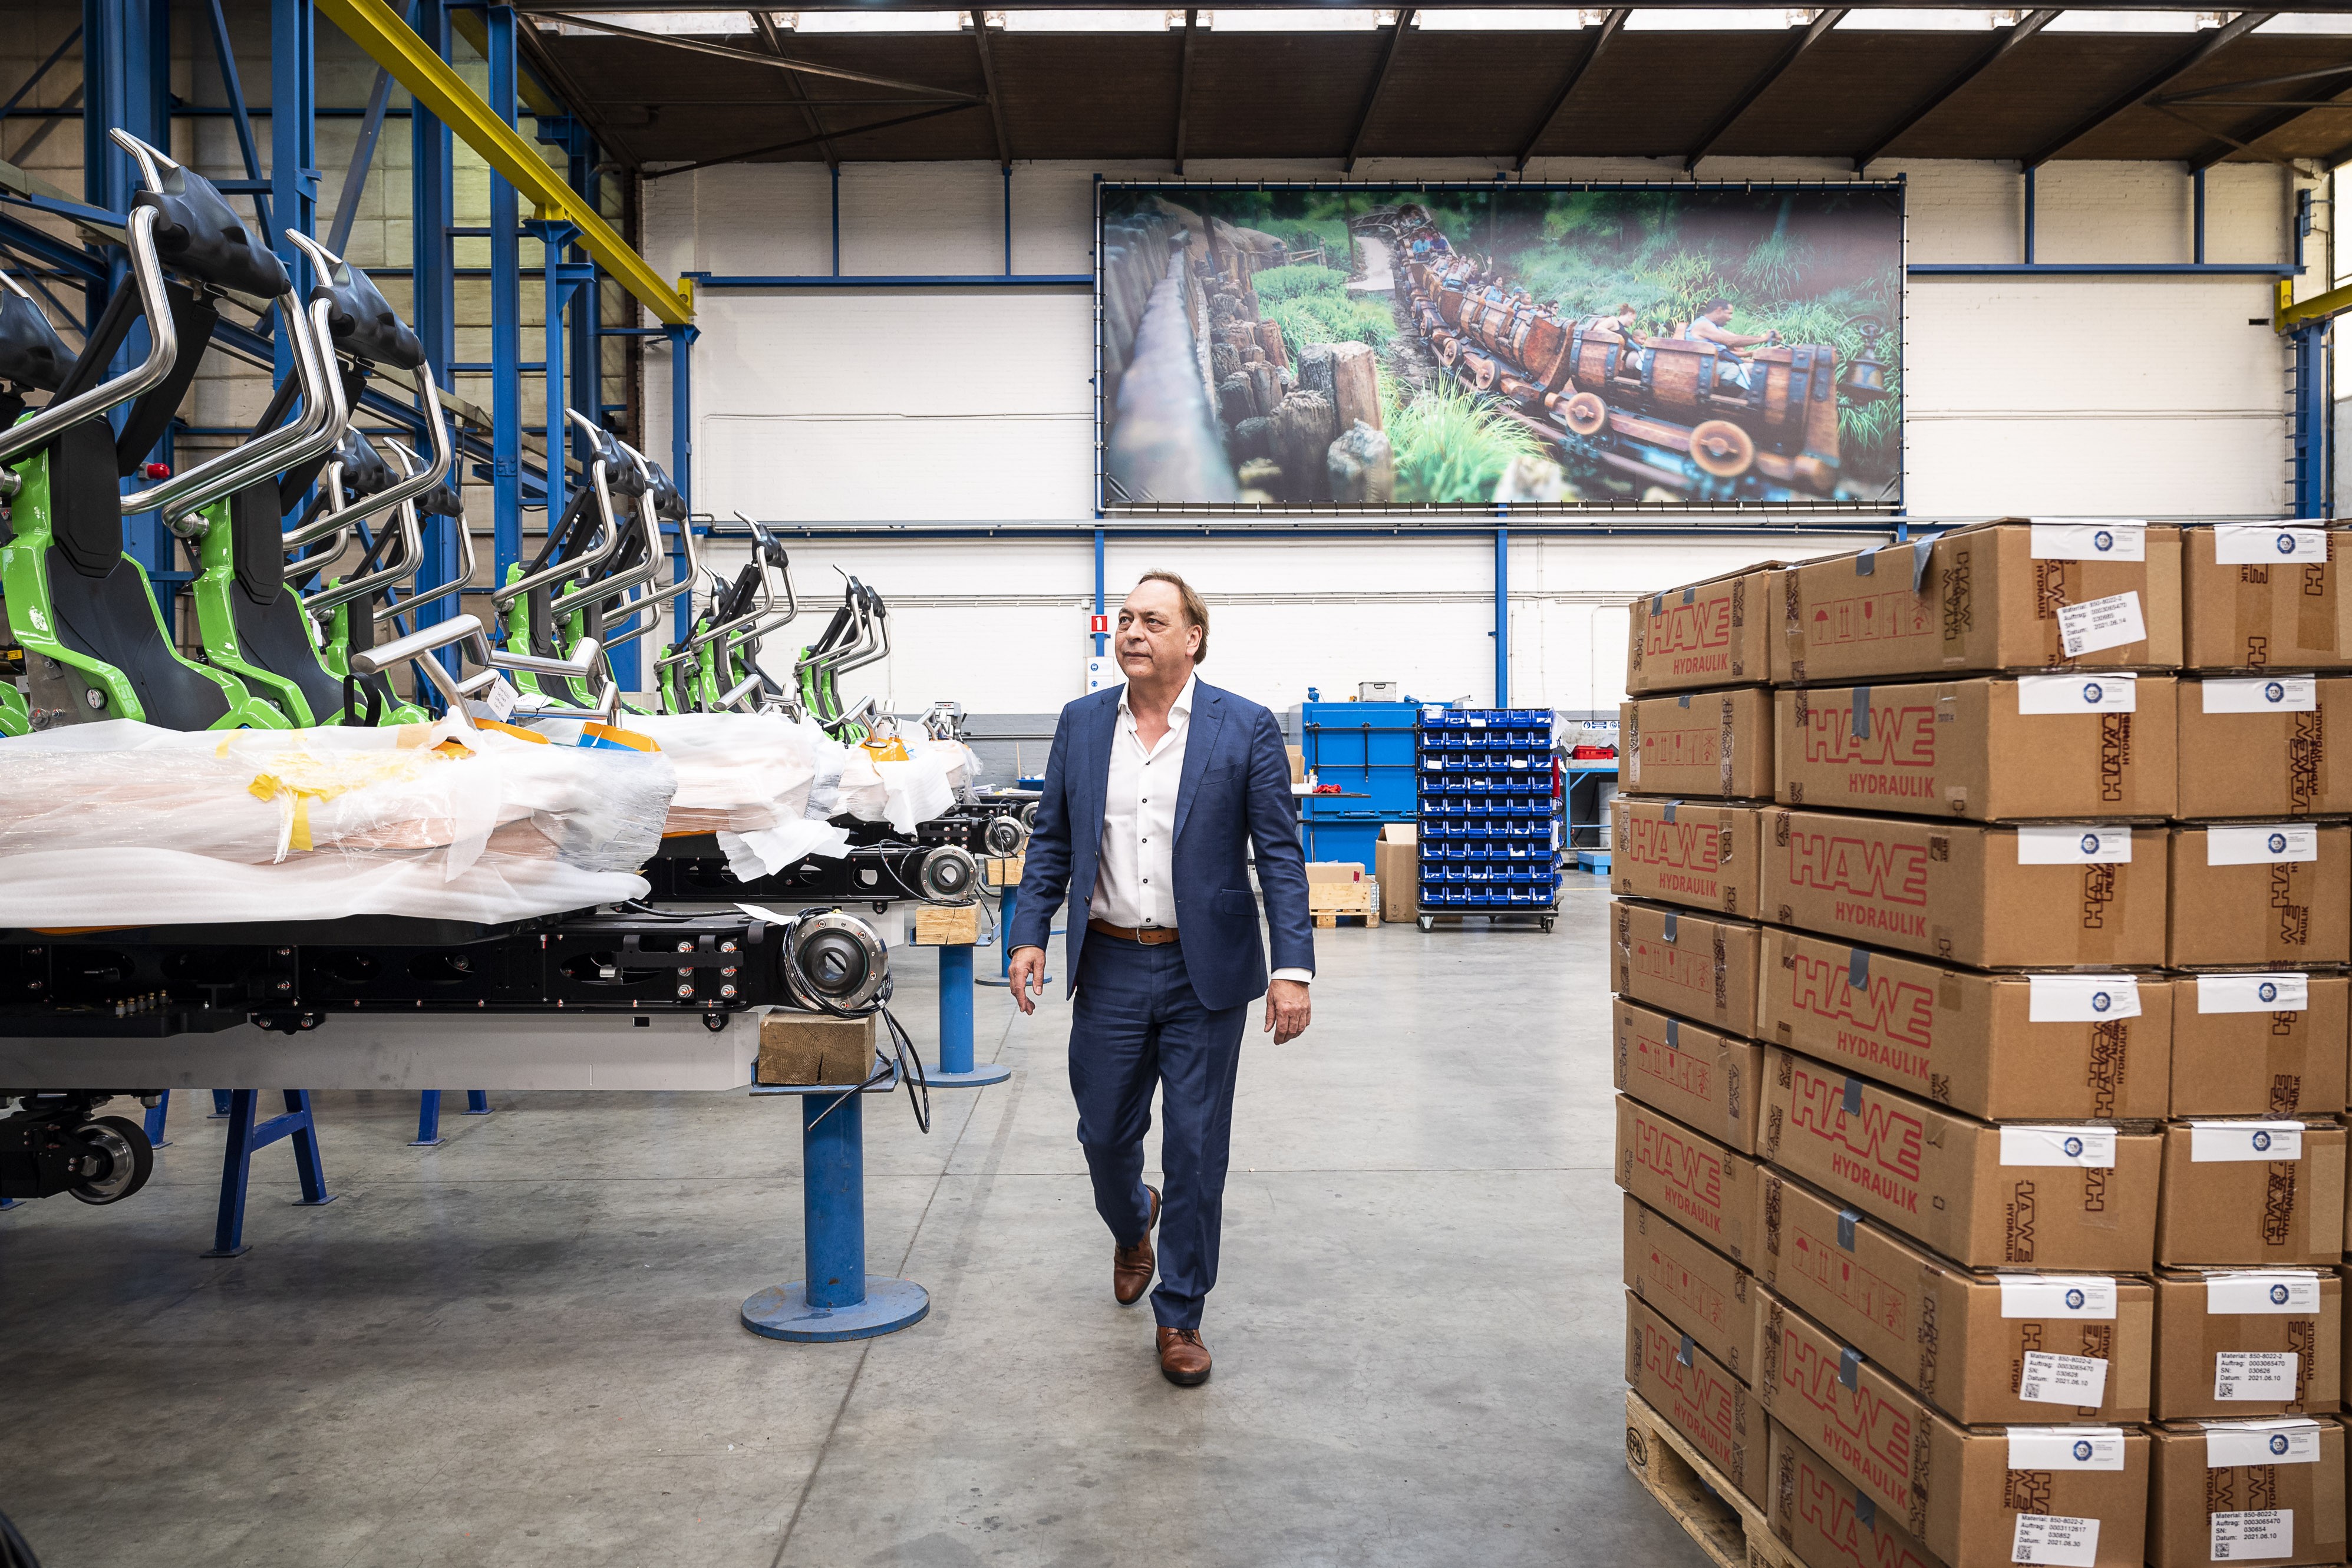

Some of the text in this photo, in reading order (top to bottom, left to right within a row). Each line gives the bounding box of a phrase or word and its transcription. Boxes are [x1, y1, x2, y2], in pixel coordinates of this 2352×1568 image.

[1647, 596, 1730, 656] HAWE
[1673, 652, 1728, 675] HYDRAULIK
[1805, 706, 1935, 768] HAWE
[1849, 773, 1935, 798] HYDRAULIK
[1630, 817, 1718, 873] HAWE
[1789, 831, 1928, 907] HAWE
[1659, 873, 1717, 898] HYDRAULIK
[1835, 900, 1927, 939] HYDRAULIK
[1792, 954, 1934, 1049] HAWE
[1837, 1031, 1930, 1082] HYDRAULIK
[1791, 1070, 1924, 1183] HAWE
[1635, 1118, 1721, 1209] HAWE
[1832, 1153, 1919, 1214] HYDRAULIK
[1664, 1186, 1721, 1234] HYDRAULIK
[2005, 1203, 2014, 1263] HYDRAULIK
[2030, 1360, 2053, 1368] Auftrag:
[2307, 1321, 2315, 1381] HYDRAULIK
[1645, 1323, 1731, 1440] HAWE
[1782, 1329, 1911, 1478] HAWE
[1629, 1432, 1645, 1463] EPAL
[1674, 1399, 1731, 1466] HYDRAULIK
[1823, 1424, 1908, 1510] HYDRAULIK
[2021, 1522, 2044, 1530] Auftrag:
[2050, 1517, 2084, 1525] 850-8022-2
